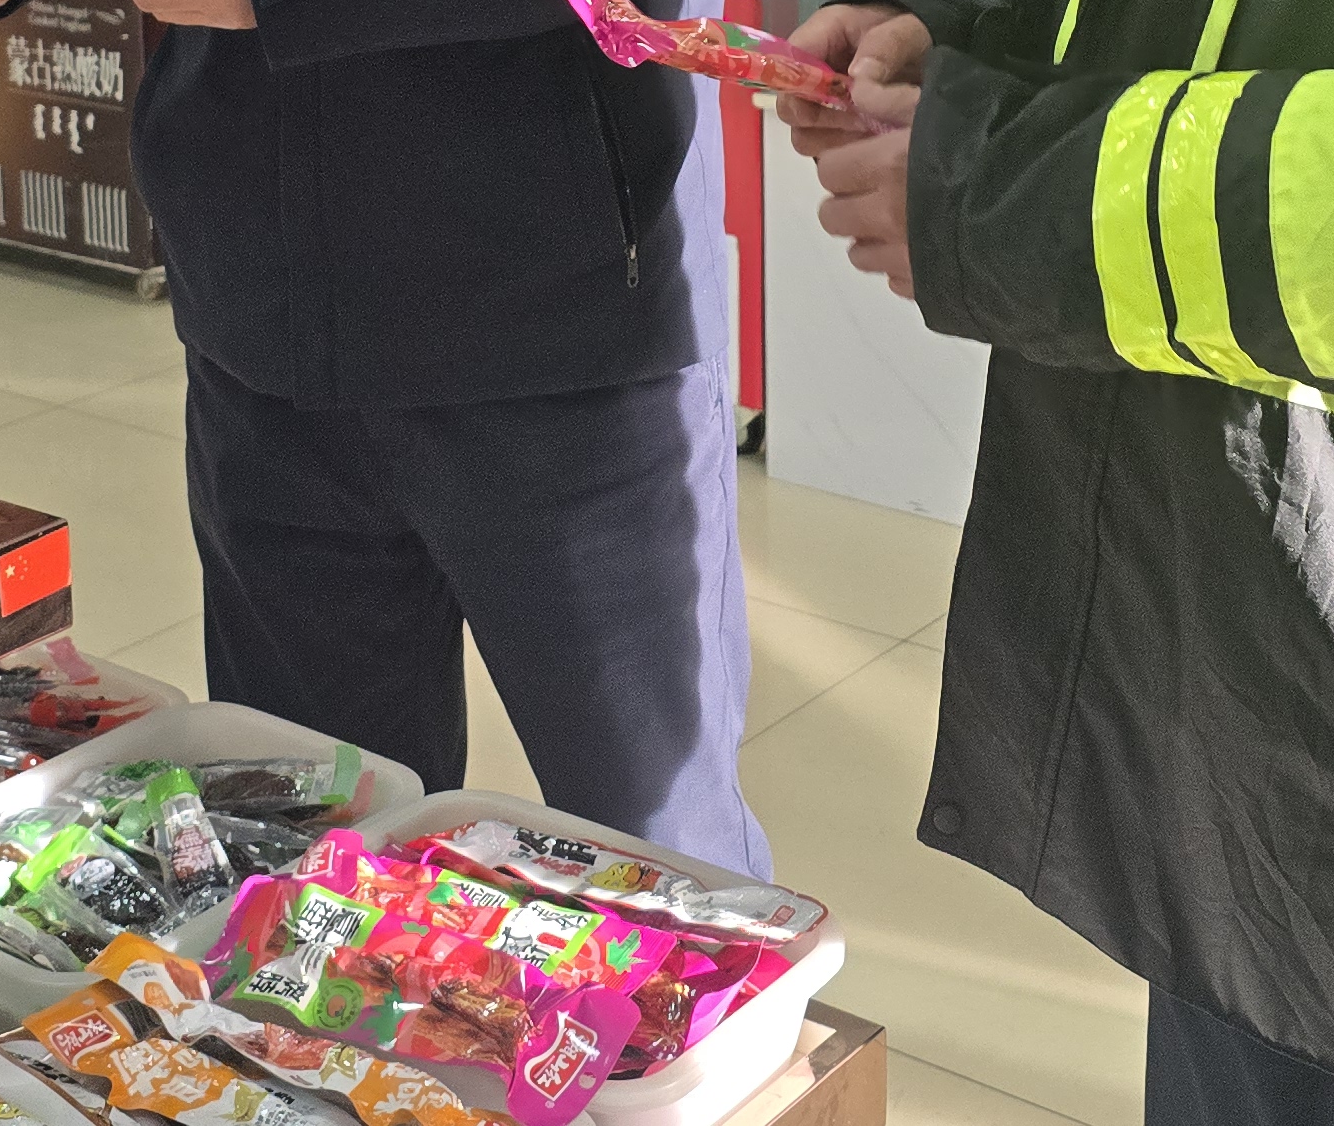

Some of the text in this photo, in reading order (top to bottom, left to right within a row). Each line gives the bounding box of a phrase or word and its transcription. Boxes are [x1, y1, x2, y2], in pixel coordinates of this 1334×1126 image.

[7, 34, 124, 102] 蒙古熟酸奶
